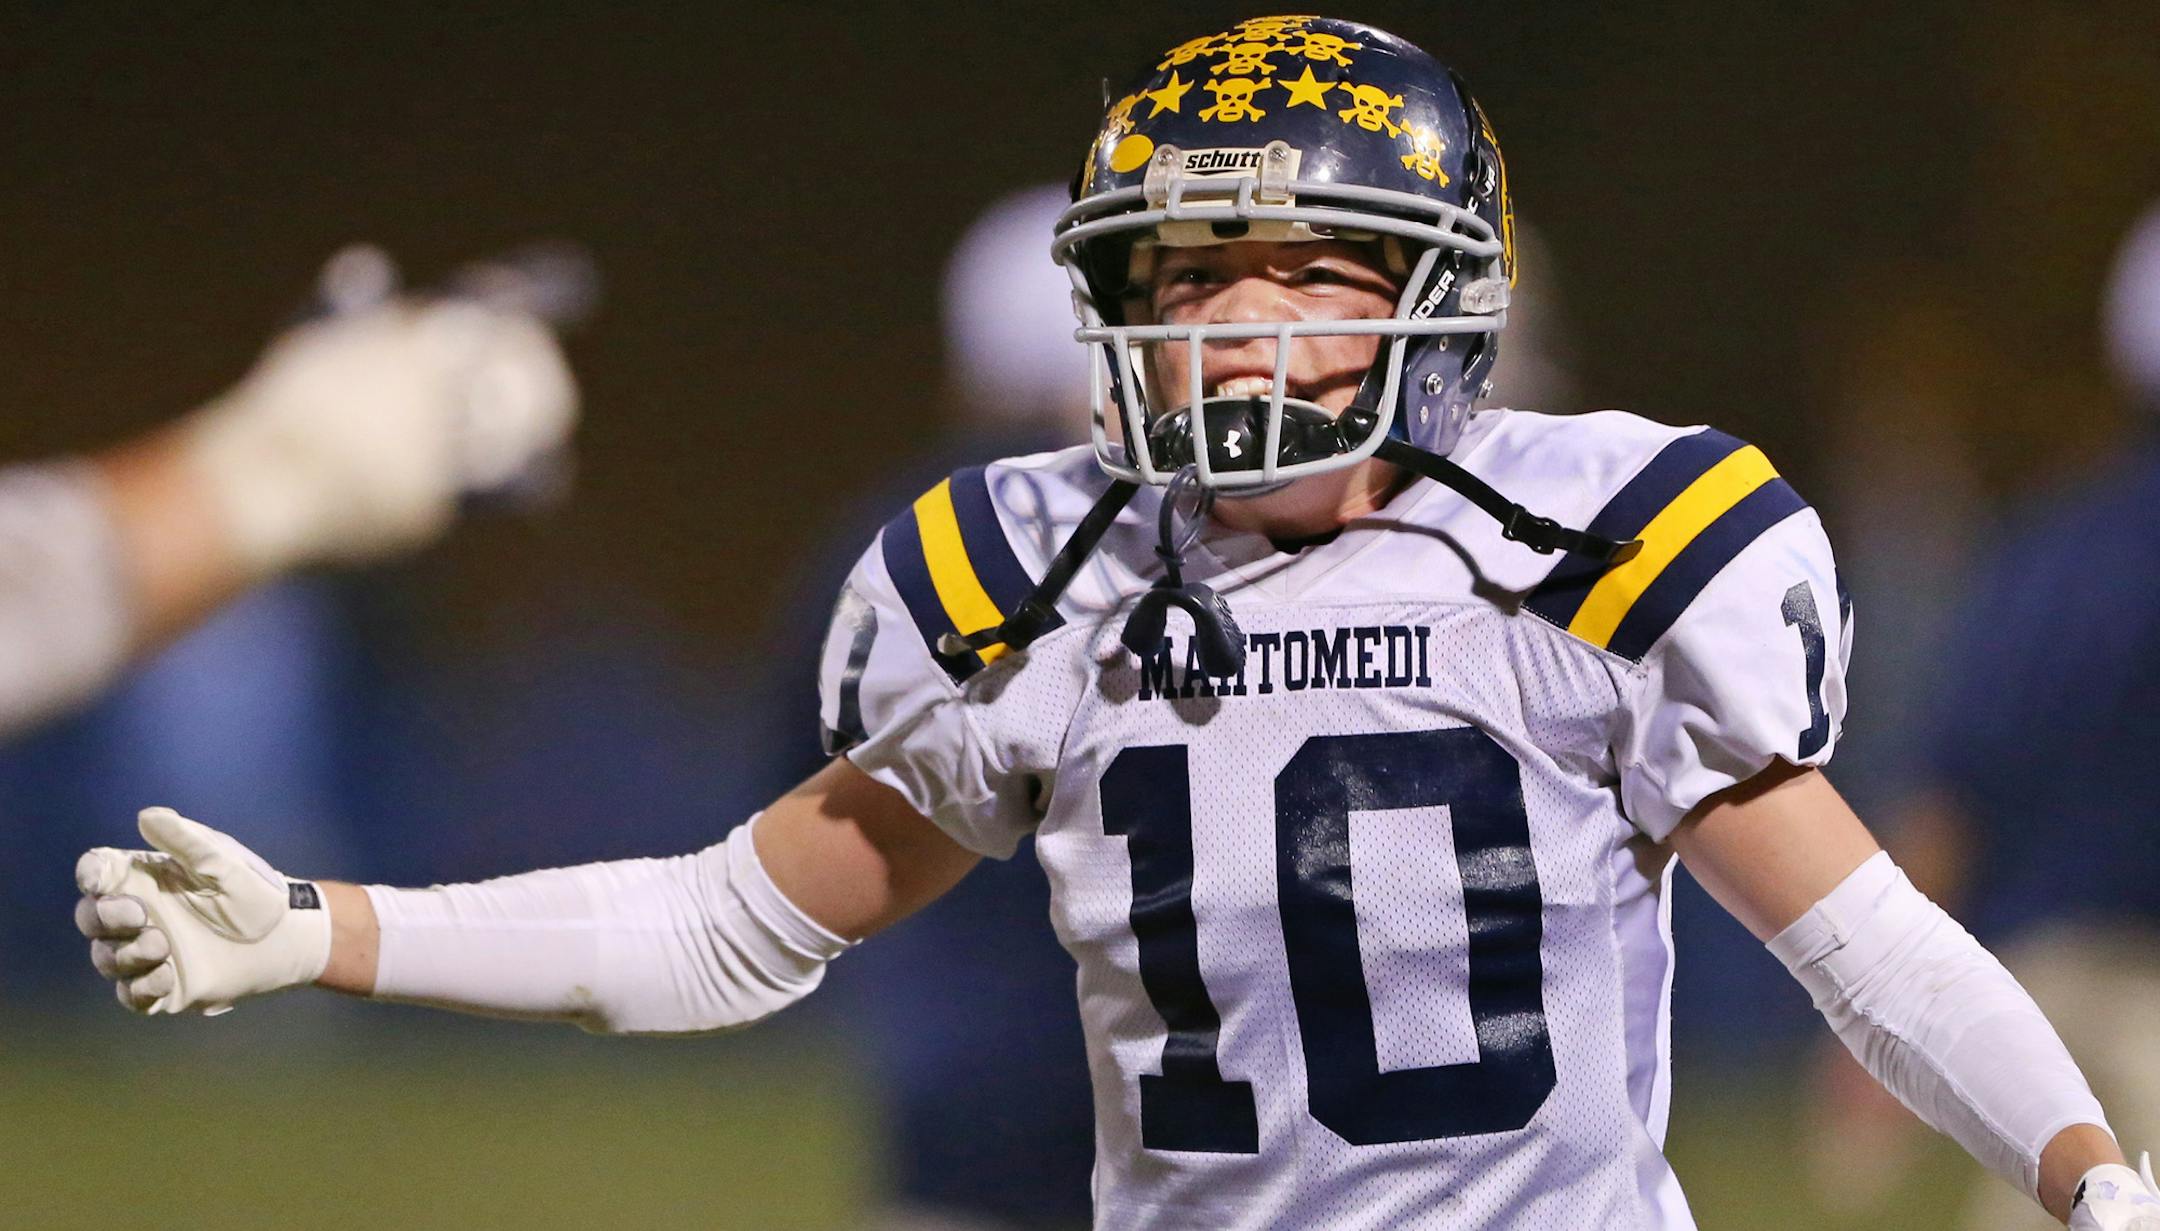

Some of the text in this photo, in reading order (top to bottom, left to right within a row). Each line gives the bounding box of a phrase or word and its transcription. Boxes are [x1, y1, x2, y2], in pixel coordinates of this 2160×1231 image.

[1184, 150, 1263, 169] schutt
[1781, 577, 1848, 761] 1
[1099, 726, 1557, 1154] 10
